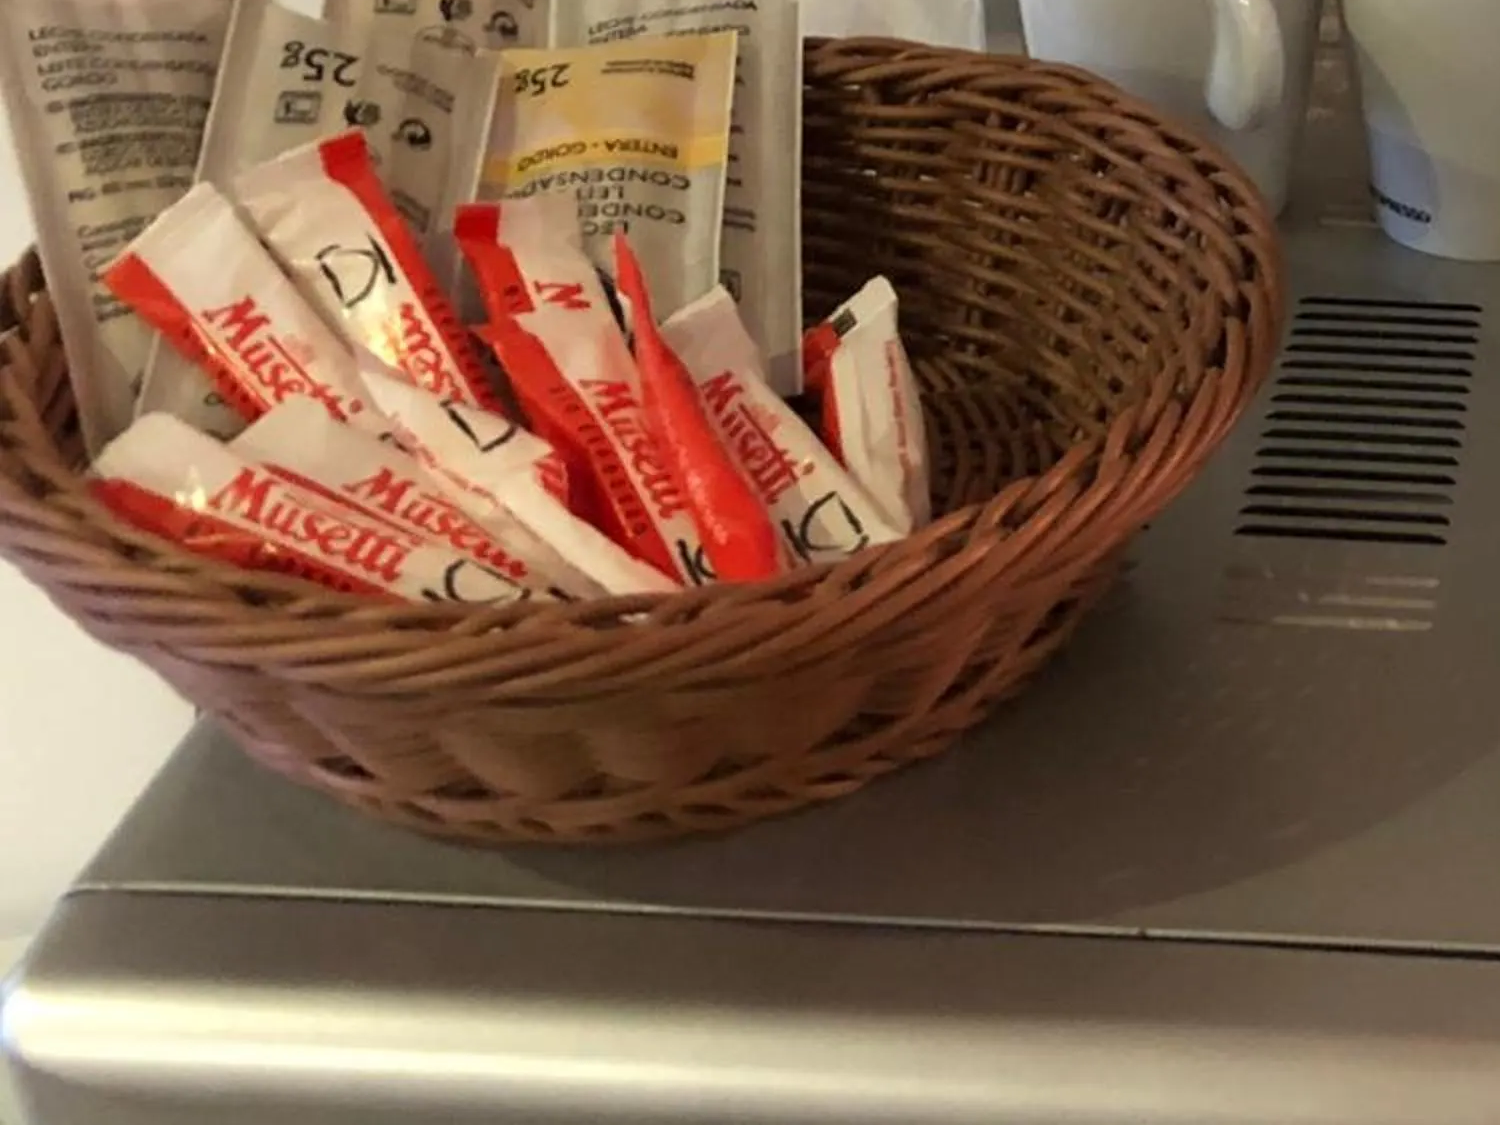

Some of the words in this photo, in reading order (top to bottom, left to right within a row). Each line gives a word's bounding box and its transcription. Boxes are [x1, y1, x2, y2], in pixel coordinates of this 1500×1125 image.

[279, 40, 360, 87] 25g
[505, 166, 692, 199] CONDENSAD
[575, 202, 687, 225] CONDE
[582, 220, 629, 236] LEC
[200, 295, 364, 423] Muse
[702, 370, 816, 505] Musetti
